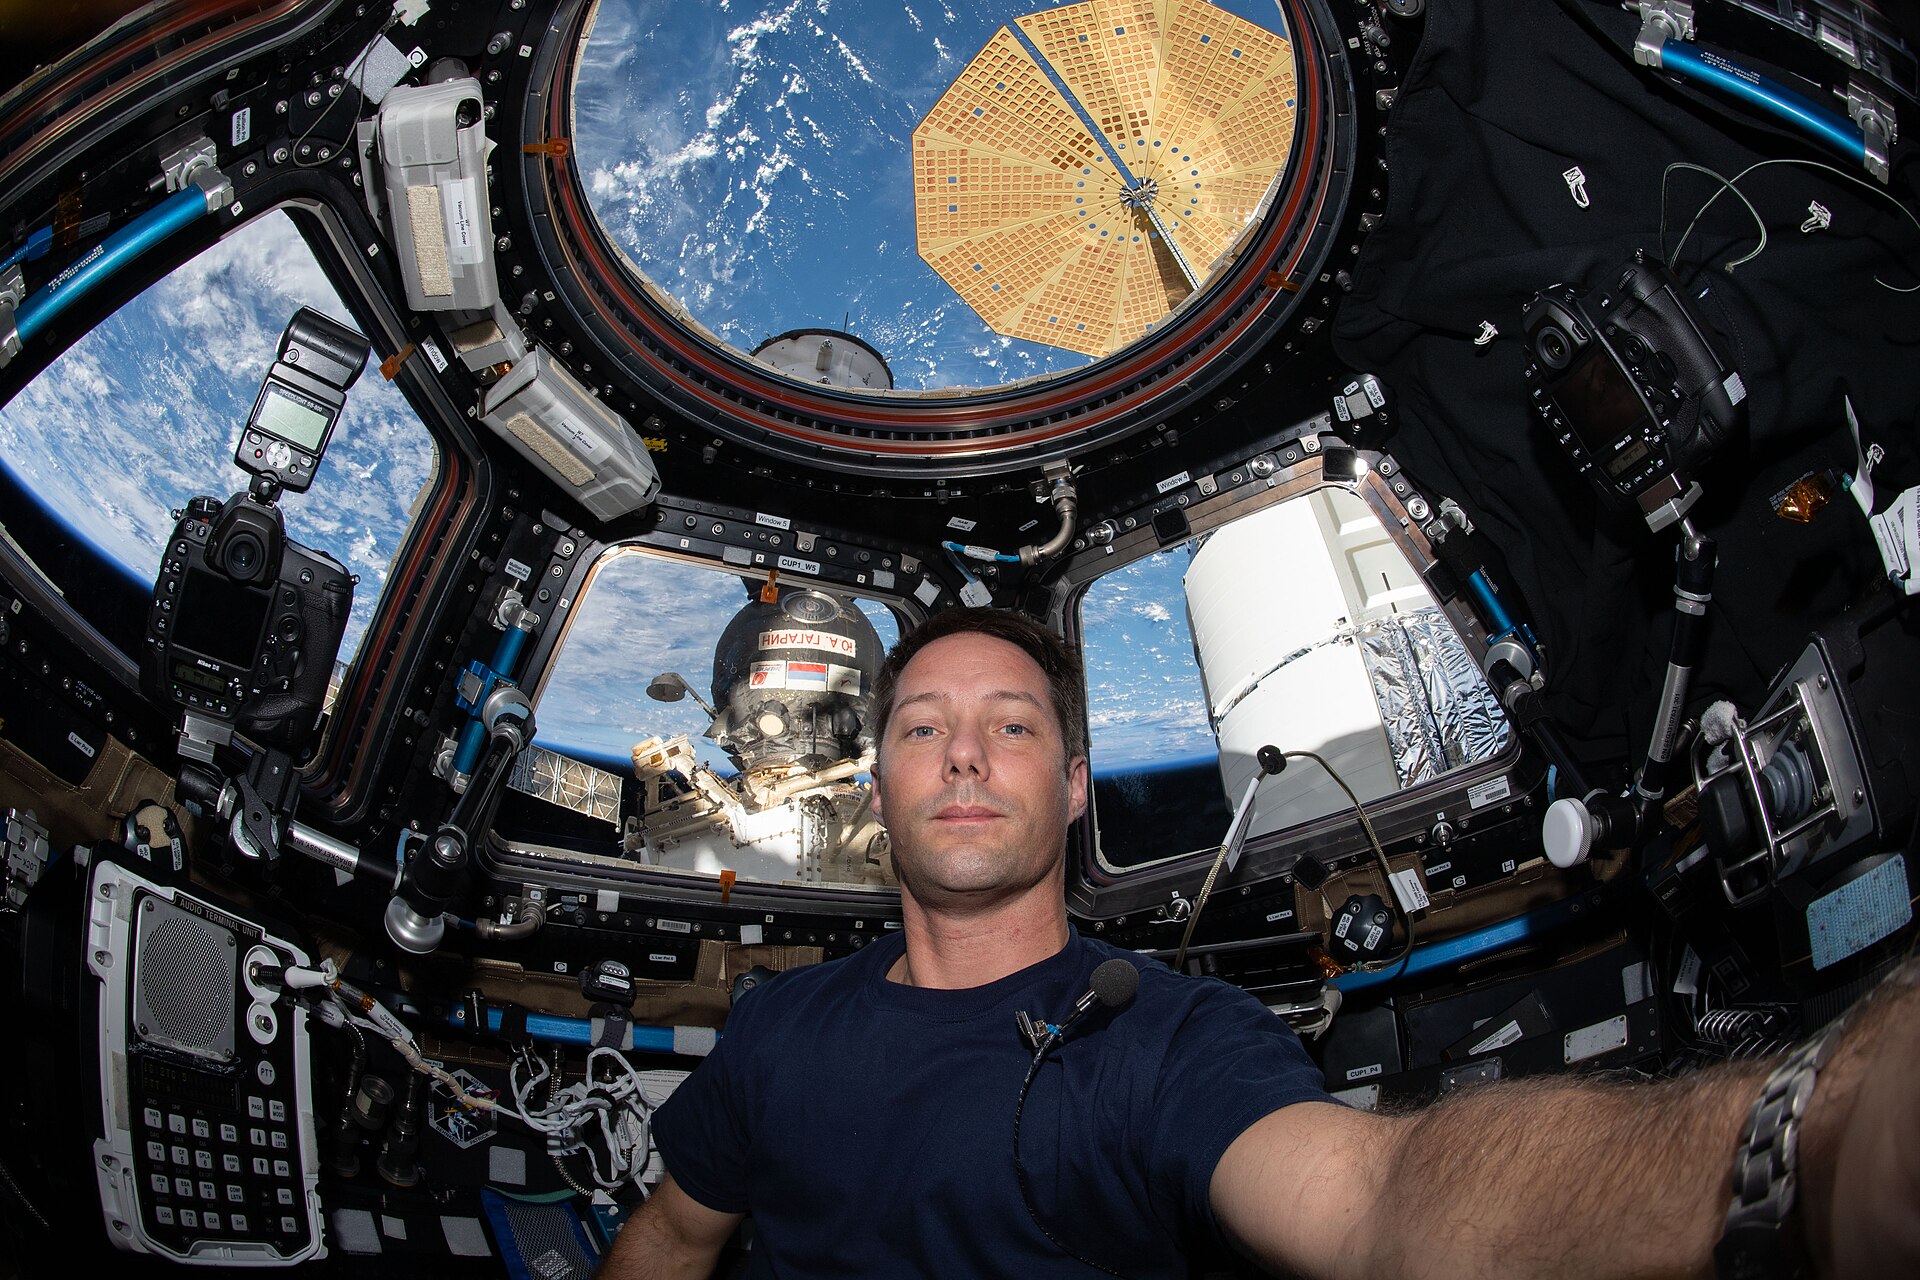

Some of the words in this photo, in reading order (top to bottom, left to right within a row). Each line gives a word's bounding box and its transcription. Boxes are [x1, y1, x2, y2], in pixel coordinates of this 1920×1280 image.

[423, 339, 443, 363] Window
[1336, 399, 1344, 418] CLOSED
[581, 439, 593, 449] Cover
[1160, 478, 1180, 489] Window
[758, 515, 781, 526] Window
[782, 559, 816, 571] CUP1_W5
[761, 631, 820, 646] ГАГАРИН
[824, 635, 852, 650] Ю.А.
[321, 848, 353, 868] BRACKET
[1504, 862, 1513, 870] H
[1407, 878, 1416, 891] Camera
[178, 897, 204, 916] AUDIO
[203, 908, 242, 932] TERMINAL
[240, 924, 259, 939] UNIT
[1369, 929, 1380, 948] CLOSED
[556, 963, 565, 972] C
[261, 1068, 272, 1077] PTT
[1350, 1066, 1378, 1078] CUP1_P4
[436, 1126, 460, 1144] BEHNKEN
[470, 1133, 489, 1144] PATRICK
